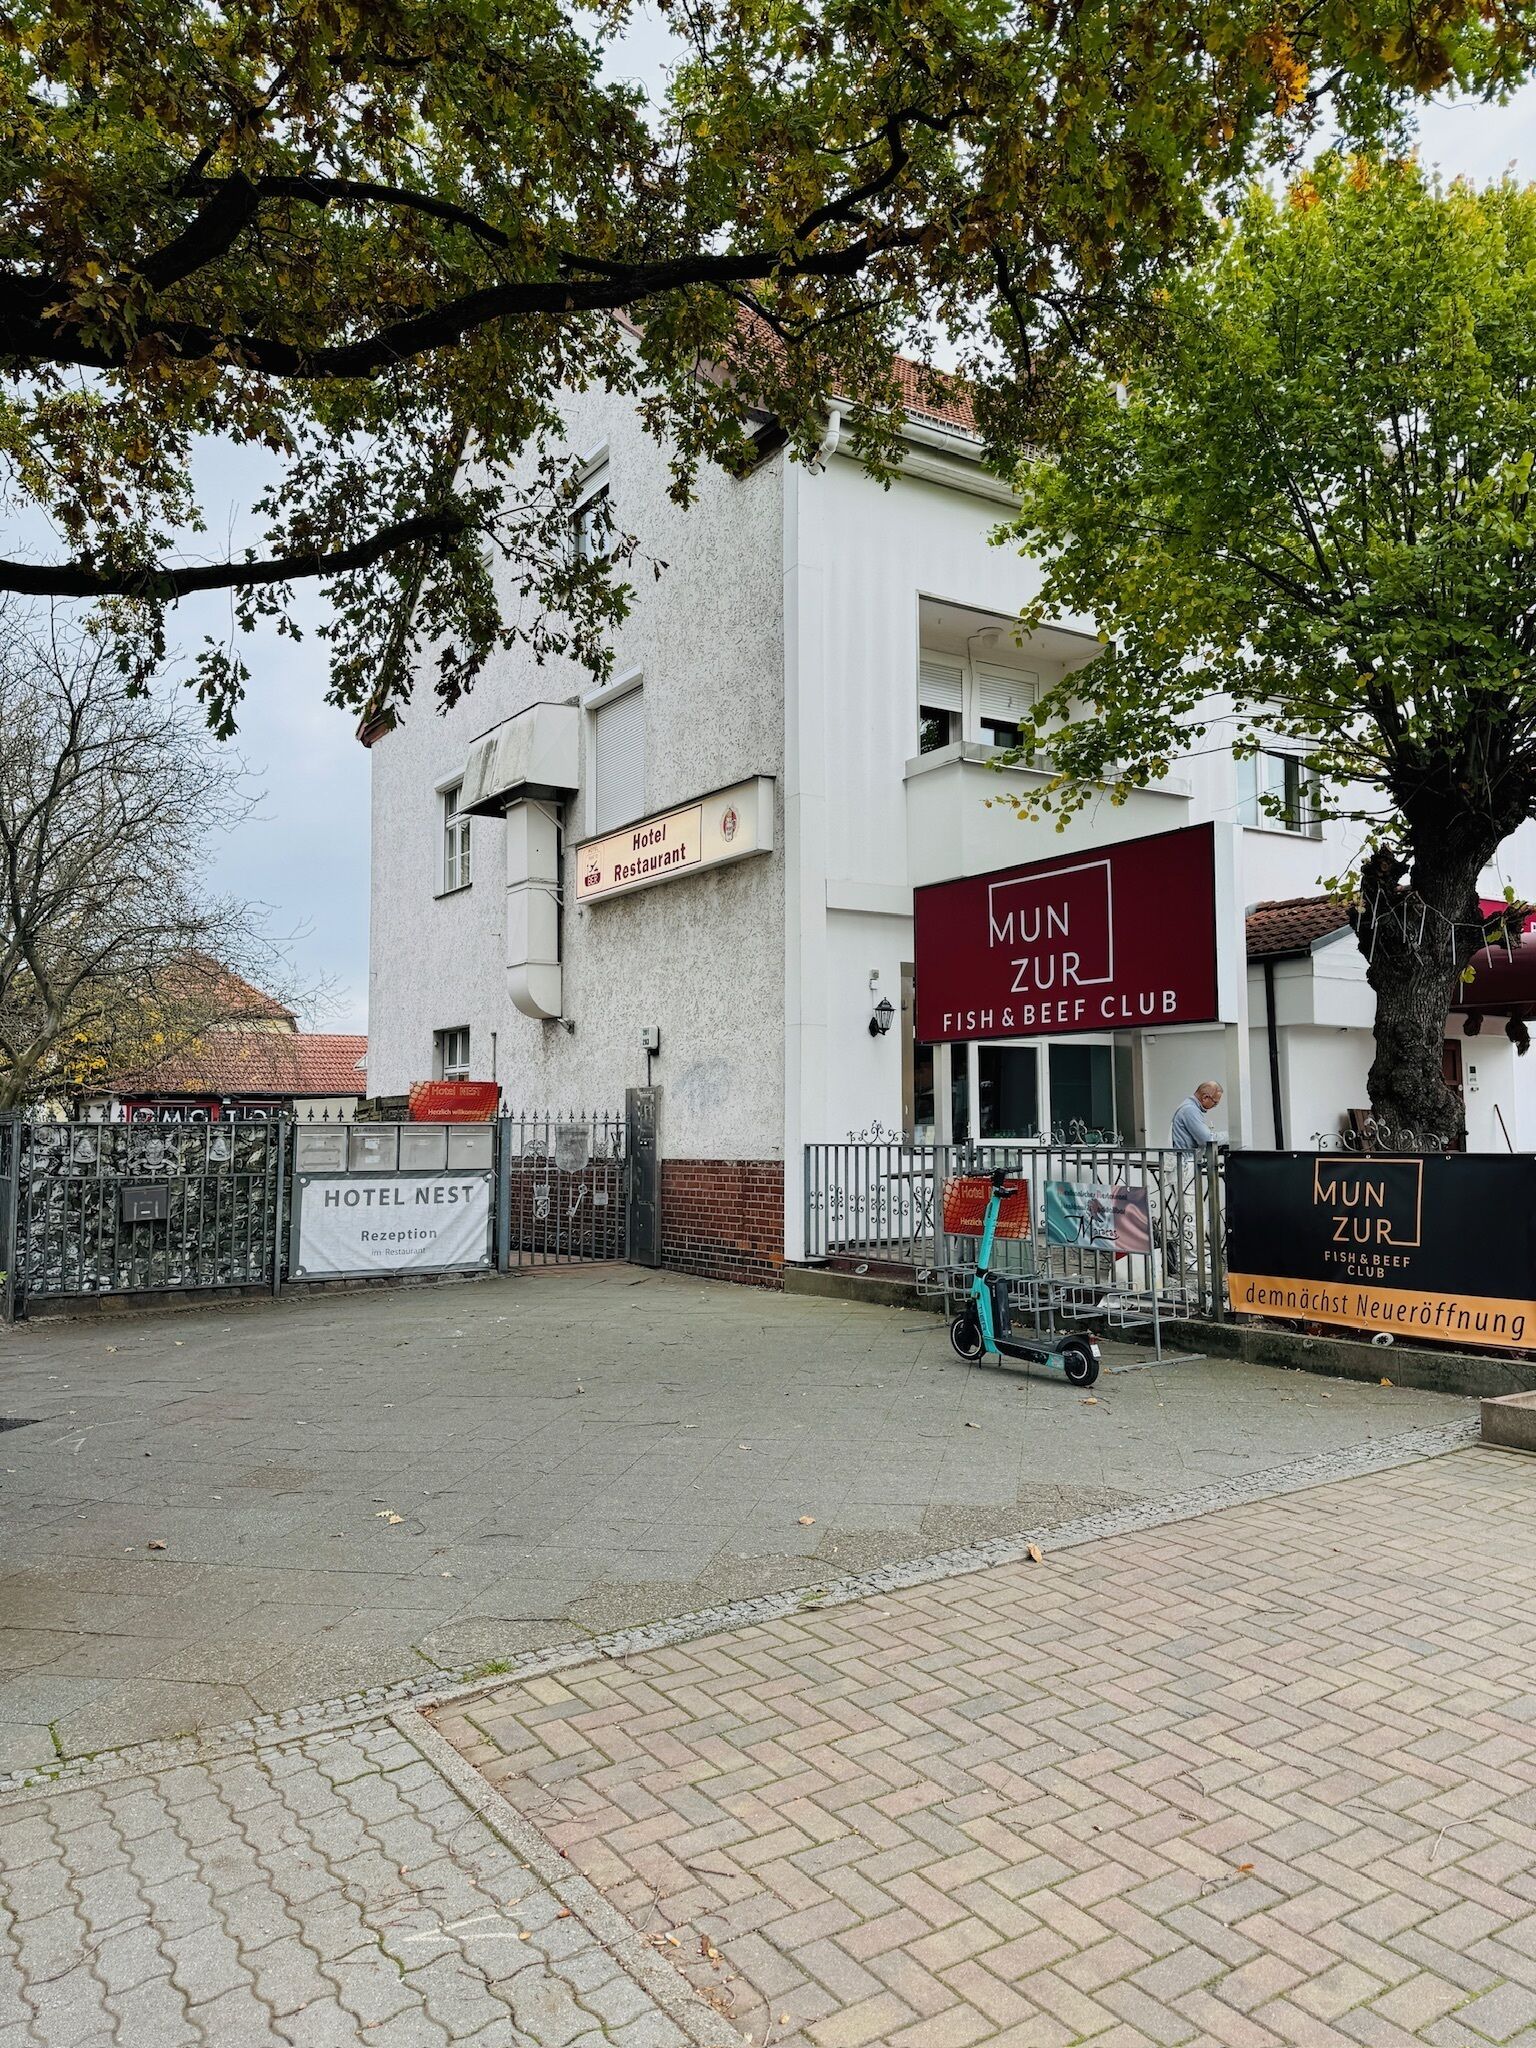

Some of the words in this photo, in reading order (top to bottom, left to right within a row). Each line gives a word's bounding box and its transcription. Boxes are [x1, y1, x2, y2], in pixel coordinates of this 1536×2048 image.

[632, 824, 666, 851] Hotel
[614, 843, 686, 882] Restaurant
[989, 902, 1069, 947] MUN
[1011, 952, 1080, 993] ZUR
[943, 1008, 993, 1032] FISH
[1023, 999, 1086, 1025] BEEF
[1100, 990, 1177, 1018] CLUB
[431, 1086, 456, 1096] Hotel
[459, 1086, 482, 1096] NEST
[324, 1187, 405, 1208] HOTEL
[415, 1185, 474, 1205] NEST
[961, 1185, 985, 1200] Hotel
[1313, 1180, 1385, 1208] MUN
[960, 1217, 983, 1227] Herzlich
[1332, 1216, 1392, 1244] ZUR
[360, 1228, 437, 1243] Rezeption
[371, 1248, 382, 1257] im
[385, 1247, 426, 1257] Restaurant
[1324, 1251, 1356, 1264] FISH
[1372, 1254, 1411, 1268] BEEF
[1347, 1264, 1385, 1278] CLUB
[1246, 1282, 1348, 1315] demnächst
[1356, 1293, 1526, 1341] Neueröffnung
